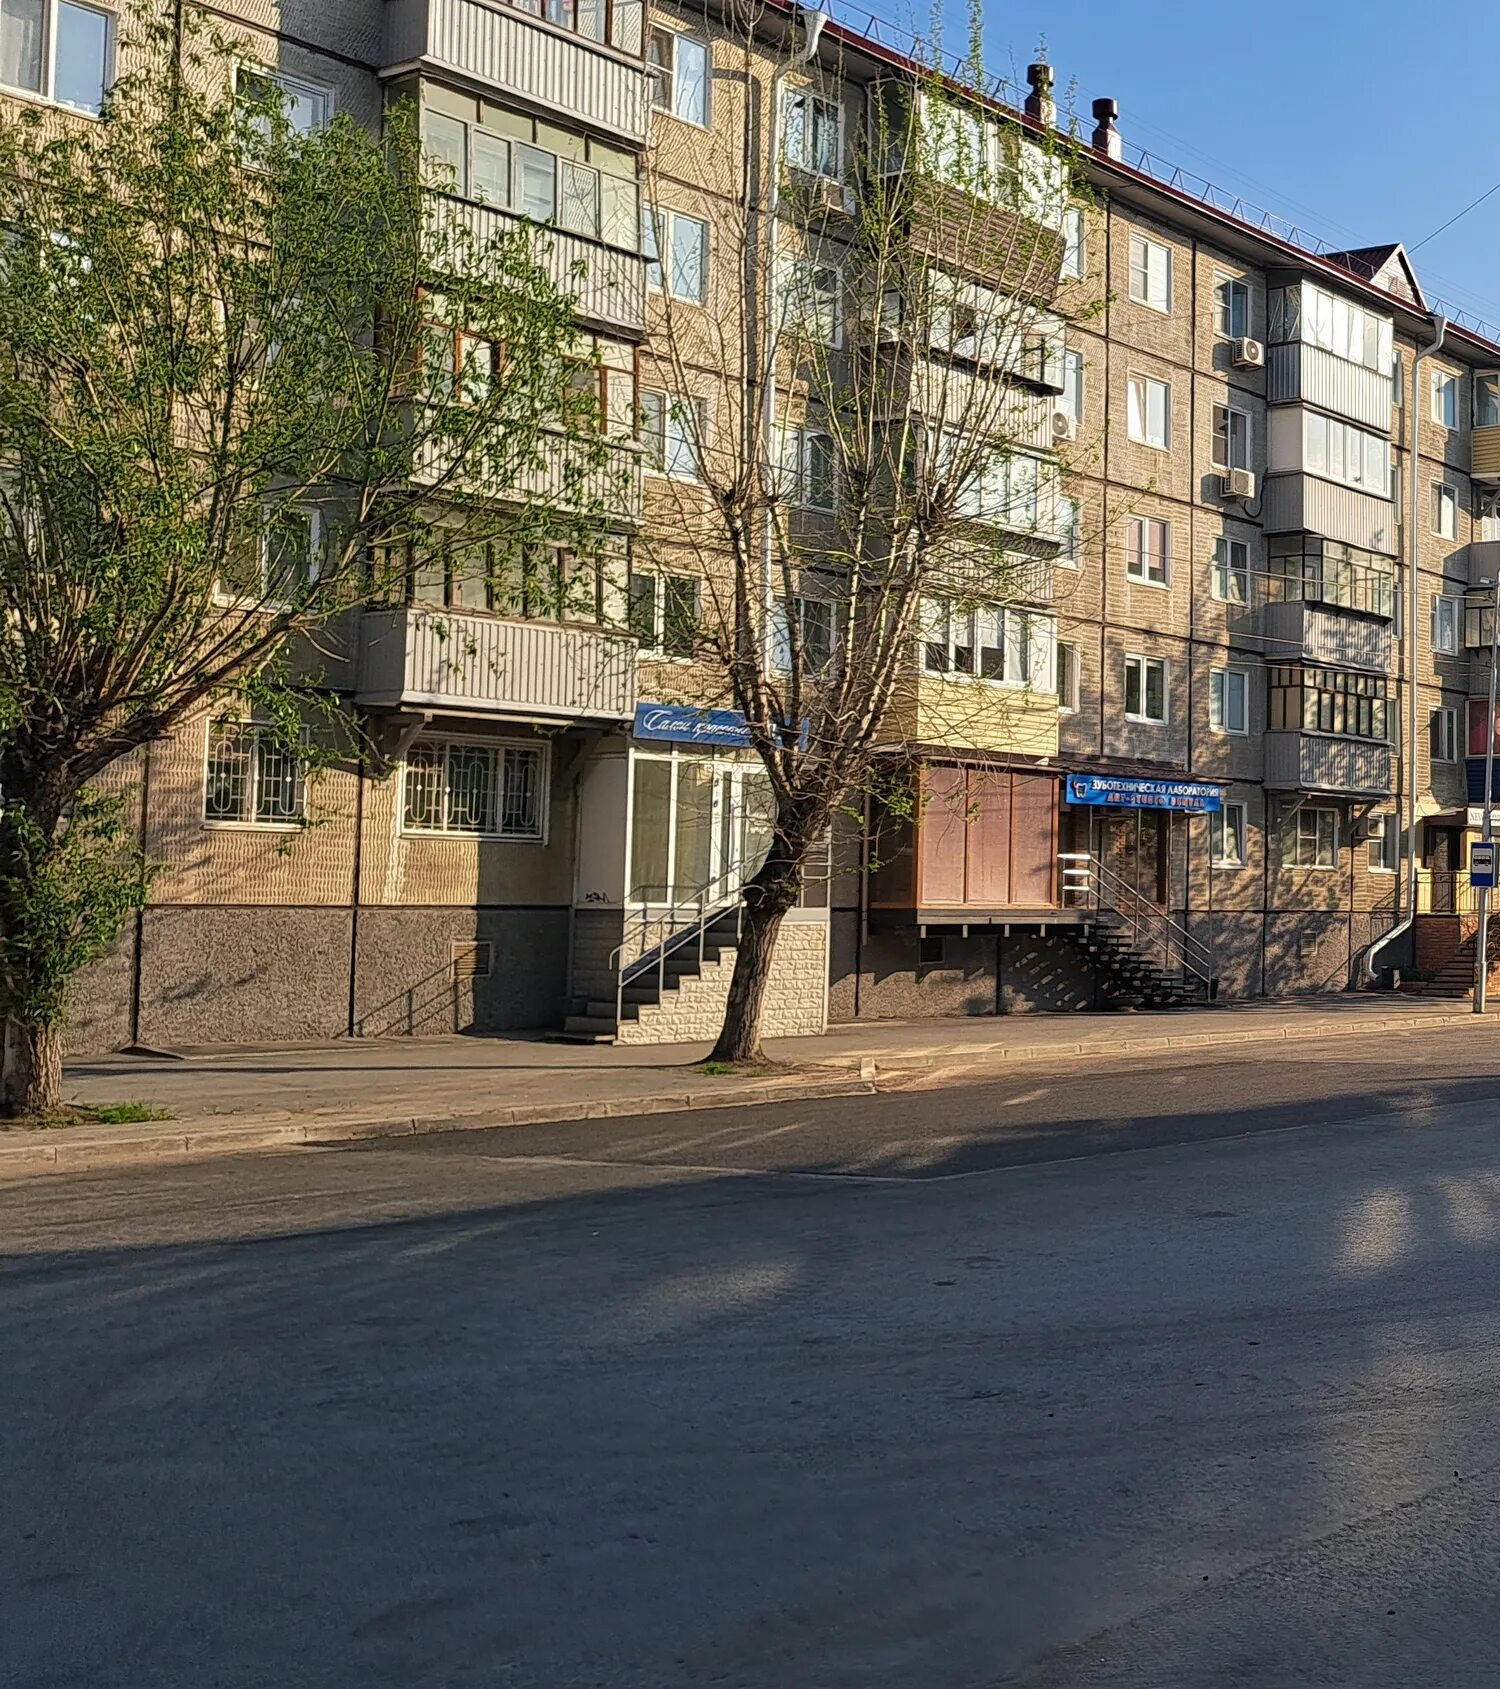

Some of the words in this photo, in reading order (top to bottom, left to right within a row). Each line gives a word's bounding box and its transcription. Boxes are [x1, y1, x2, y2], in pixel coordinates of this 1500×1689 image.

[643, 709, 691, 732] Салон
[1092, 779, 1166, 794] ЗУБОТЕХНИЧЕСКАЯ
[1167, 785, 1219, 797] ЛАБОРАТОРИЯ
